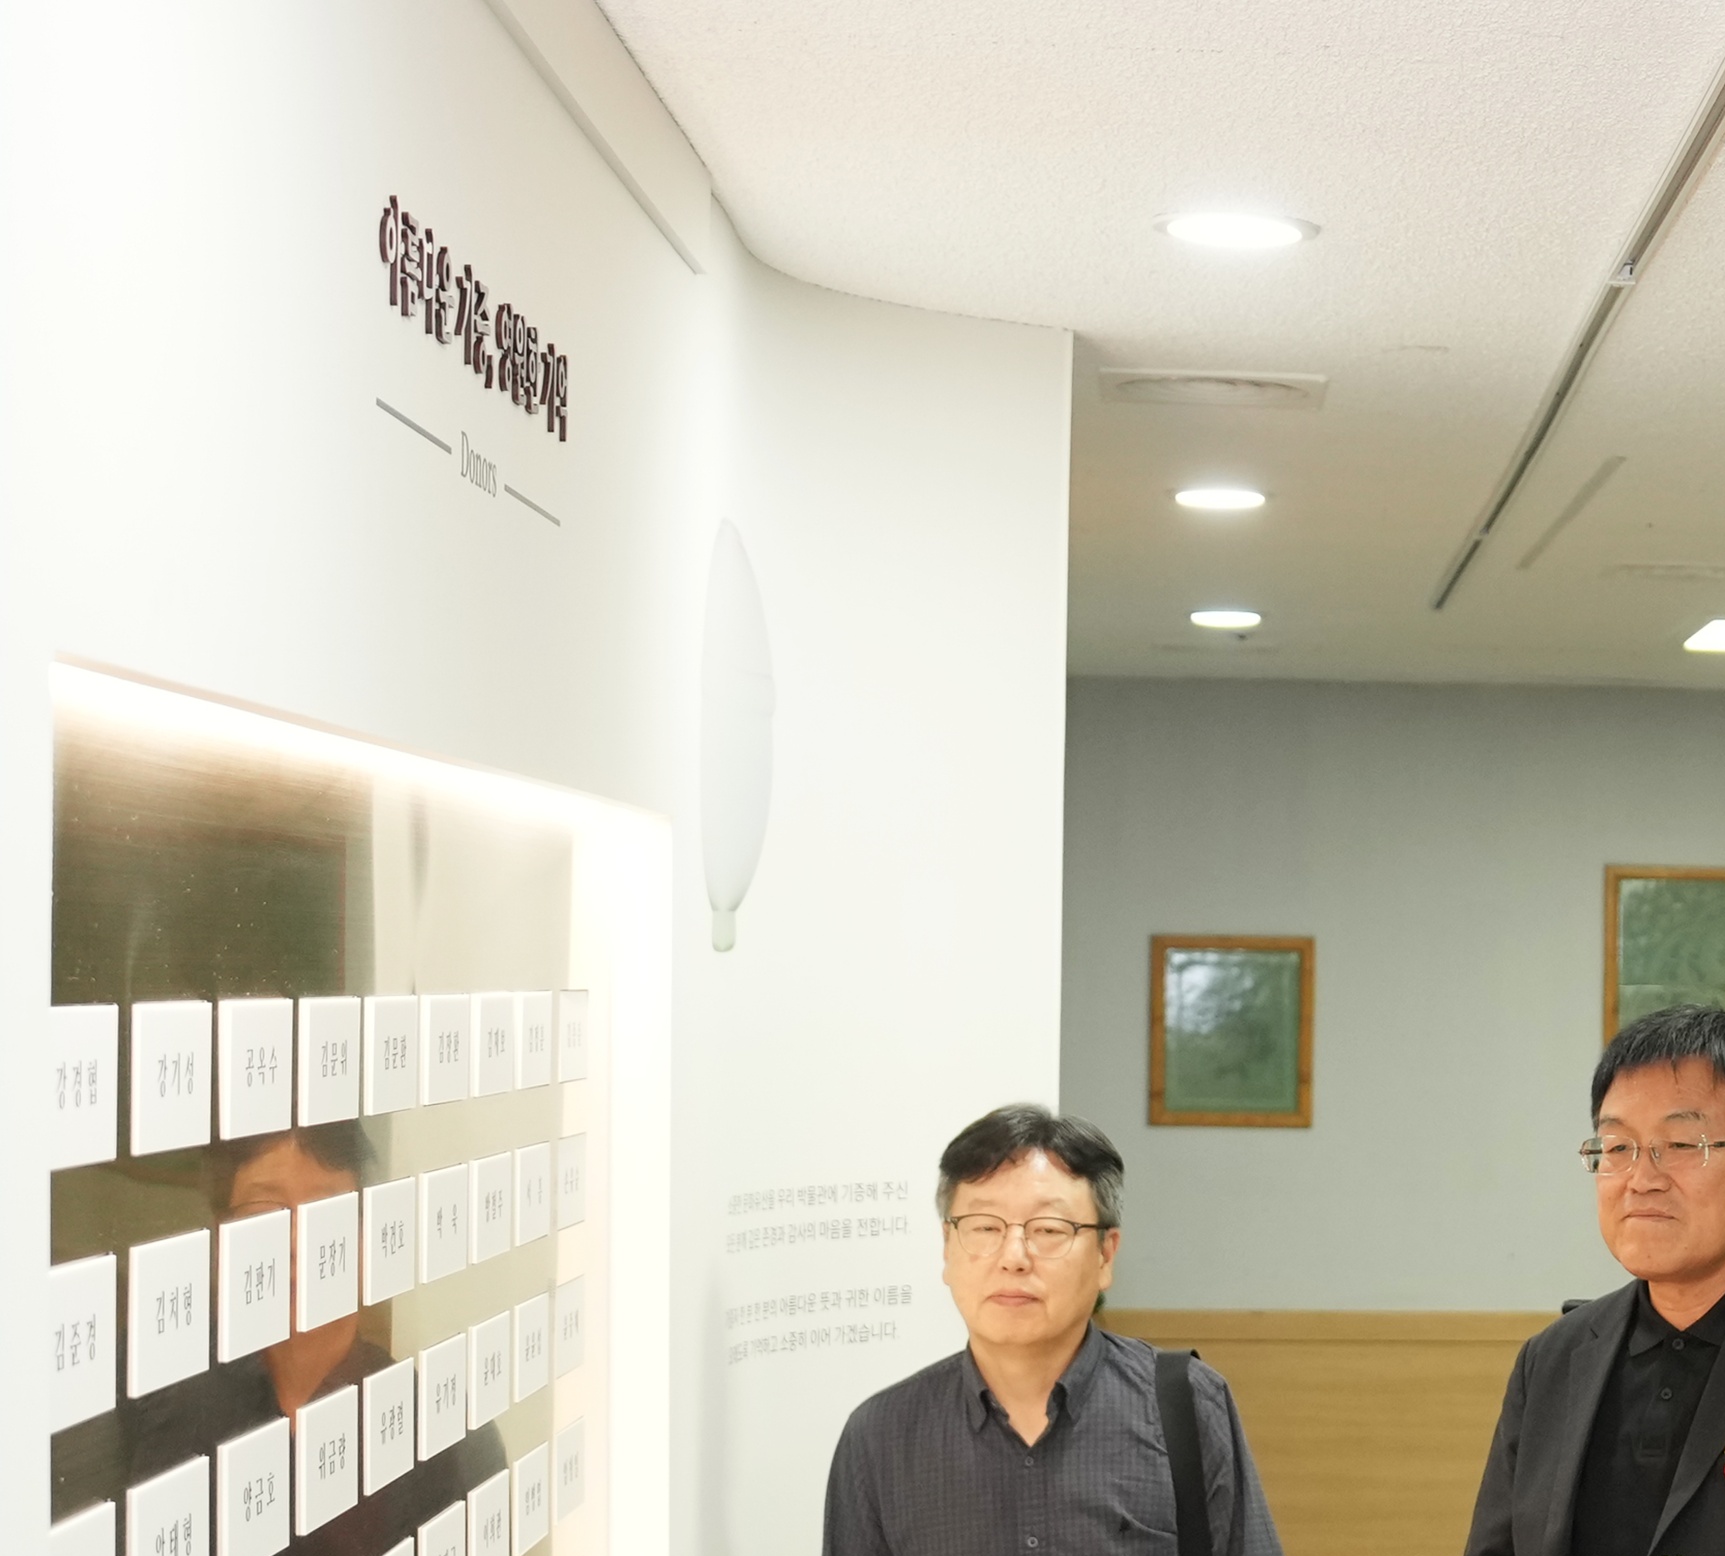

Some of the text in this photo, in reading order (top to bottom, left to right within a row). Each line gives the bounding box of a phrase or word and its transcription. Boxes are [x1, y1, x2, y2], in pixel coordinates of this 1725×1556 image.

[379, 194, 454, 344] 아름다운
[495, 303, 540, 415] 영원한
[539, 343, 568, 443] 기억
[460, 430, 498, 498] Donors
[157, 1051, 195, 1099] 강기성
[244, 1046, 278, 1088] 공옥수
[778, 1188, 795, 1207] 우리
[797, 1184, 838, 1206] 박물관에
[841, 1181, 878, 1204] 기증해
[882, 1180, 908, 1201] 주신
[788, 1221, 816, 1244] 감사의
[819, 1218, 852, 1240] 마음을
[856, 1215, 912, 1238] 전합니다.
[155, 1282, 193, 1335] 김치형
[779, 1293, 816, 1316] 아름다운
[820, 1291, 842, 1310] 뜻과
[845, 1287, 869, 1308] 귀한
[873, 1284, 912, 1305] 이름을
[780, 1330, 807, 1352] 소중히
[810, 1326, 831, 1347] 이어
[834, 1320, 900, 1344] 가겠습니다.
[242, 1471, 276, 1523] 양금호
